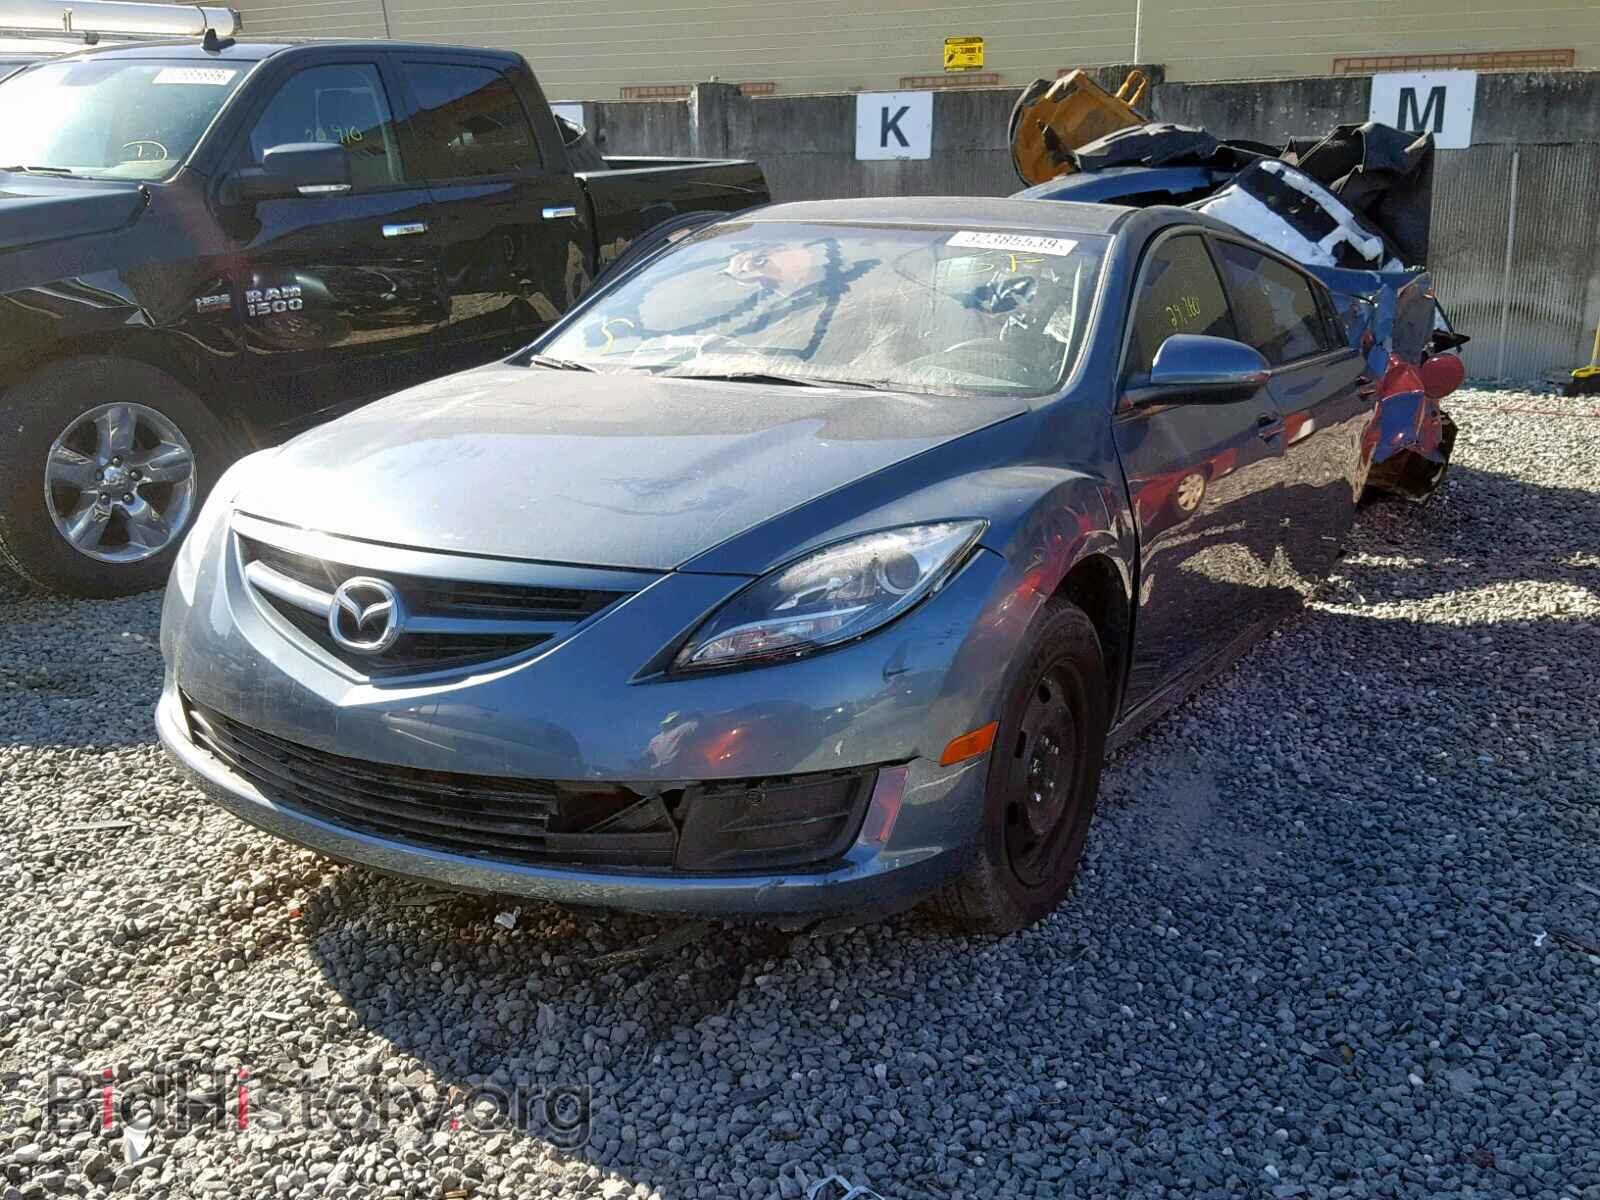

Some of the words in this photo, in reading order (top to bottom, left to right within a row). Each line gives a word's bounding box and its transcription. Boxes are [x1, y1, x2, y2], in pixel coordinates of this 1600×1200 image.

[1397, 86, 1446, 133] M
[881, 106, 911, 148] K
[246, 287, 302, 303] RAM
[248, 298, 303, 317] 1500
